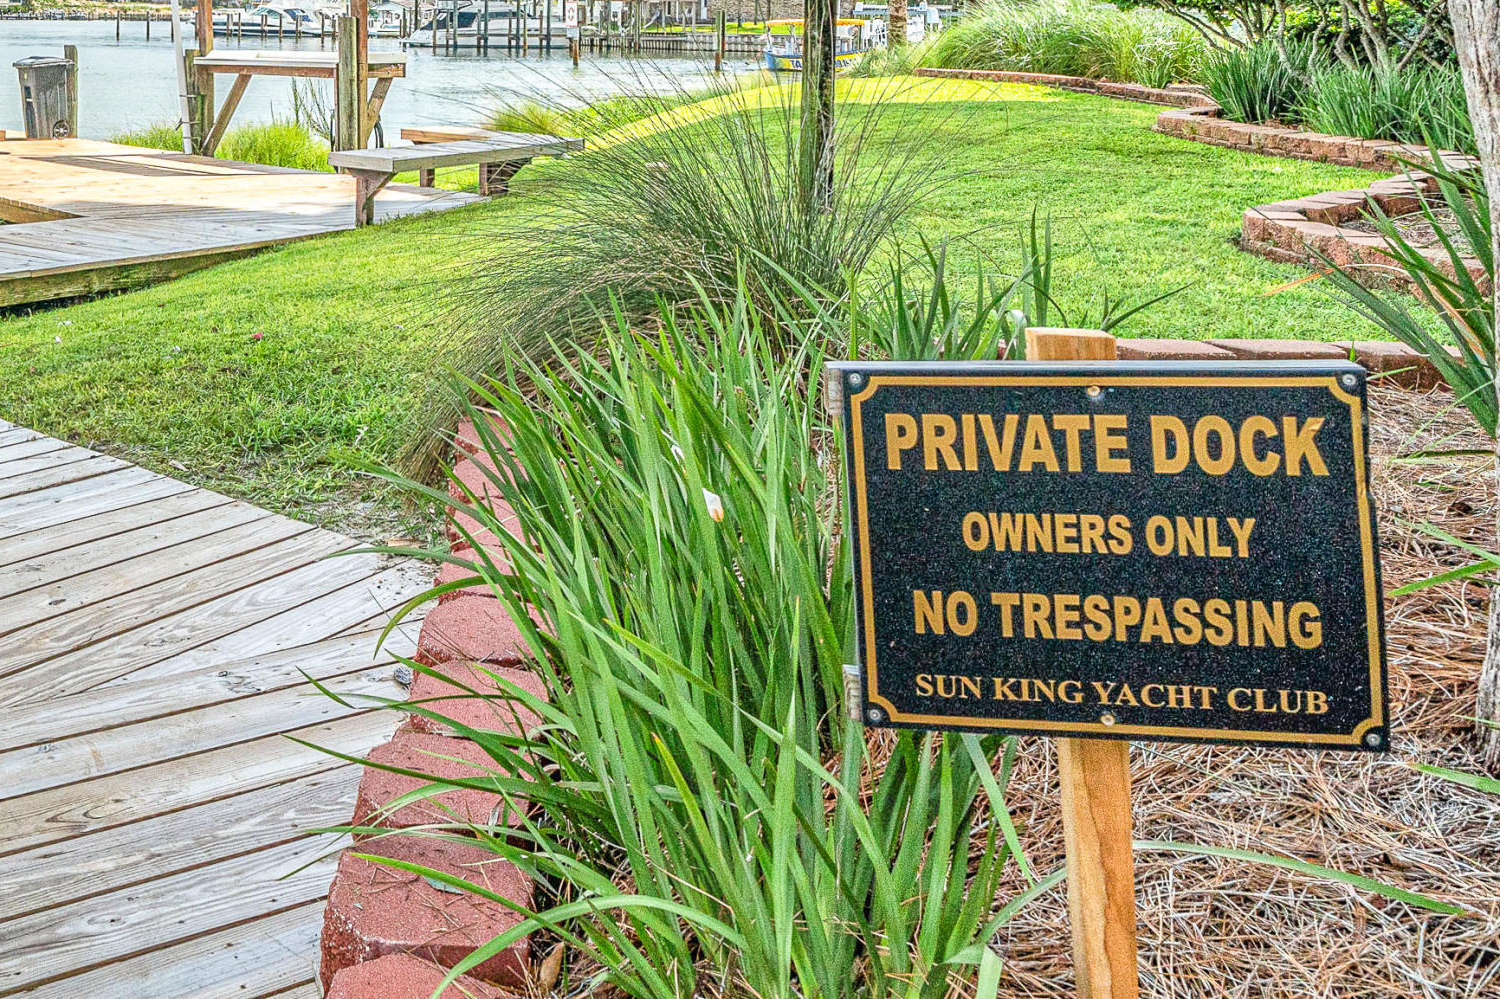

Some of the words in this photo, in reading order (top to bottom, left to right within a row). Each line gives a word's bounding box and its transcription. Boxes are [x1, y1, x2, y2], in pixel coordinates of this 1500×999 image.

[885, 413, 1131, 473] PRIVATE
[1150, 415, 1328, 476] DOCK
[962, 512, 1133, 554] OWNERS
[1146, 515, 1255, 557] ONLY
[913, 590, 977, 636] NO
[991, 592, 1322, 649] TRESPASSING
[916, 674, 980, 698] SUN
[993, 678, 1082, 703] KING
[1092, 682, 1217, 709] YACHT
[1228, 689, 1328, 713] CLUB
